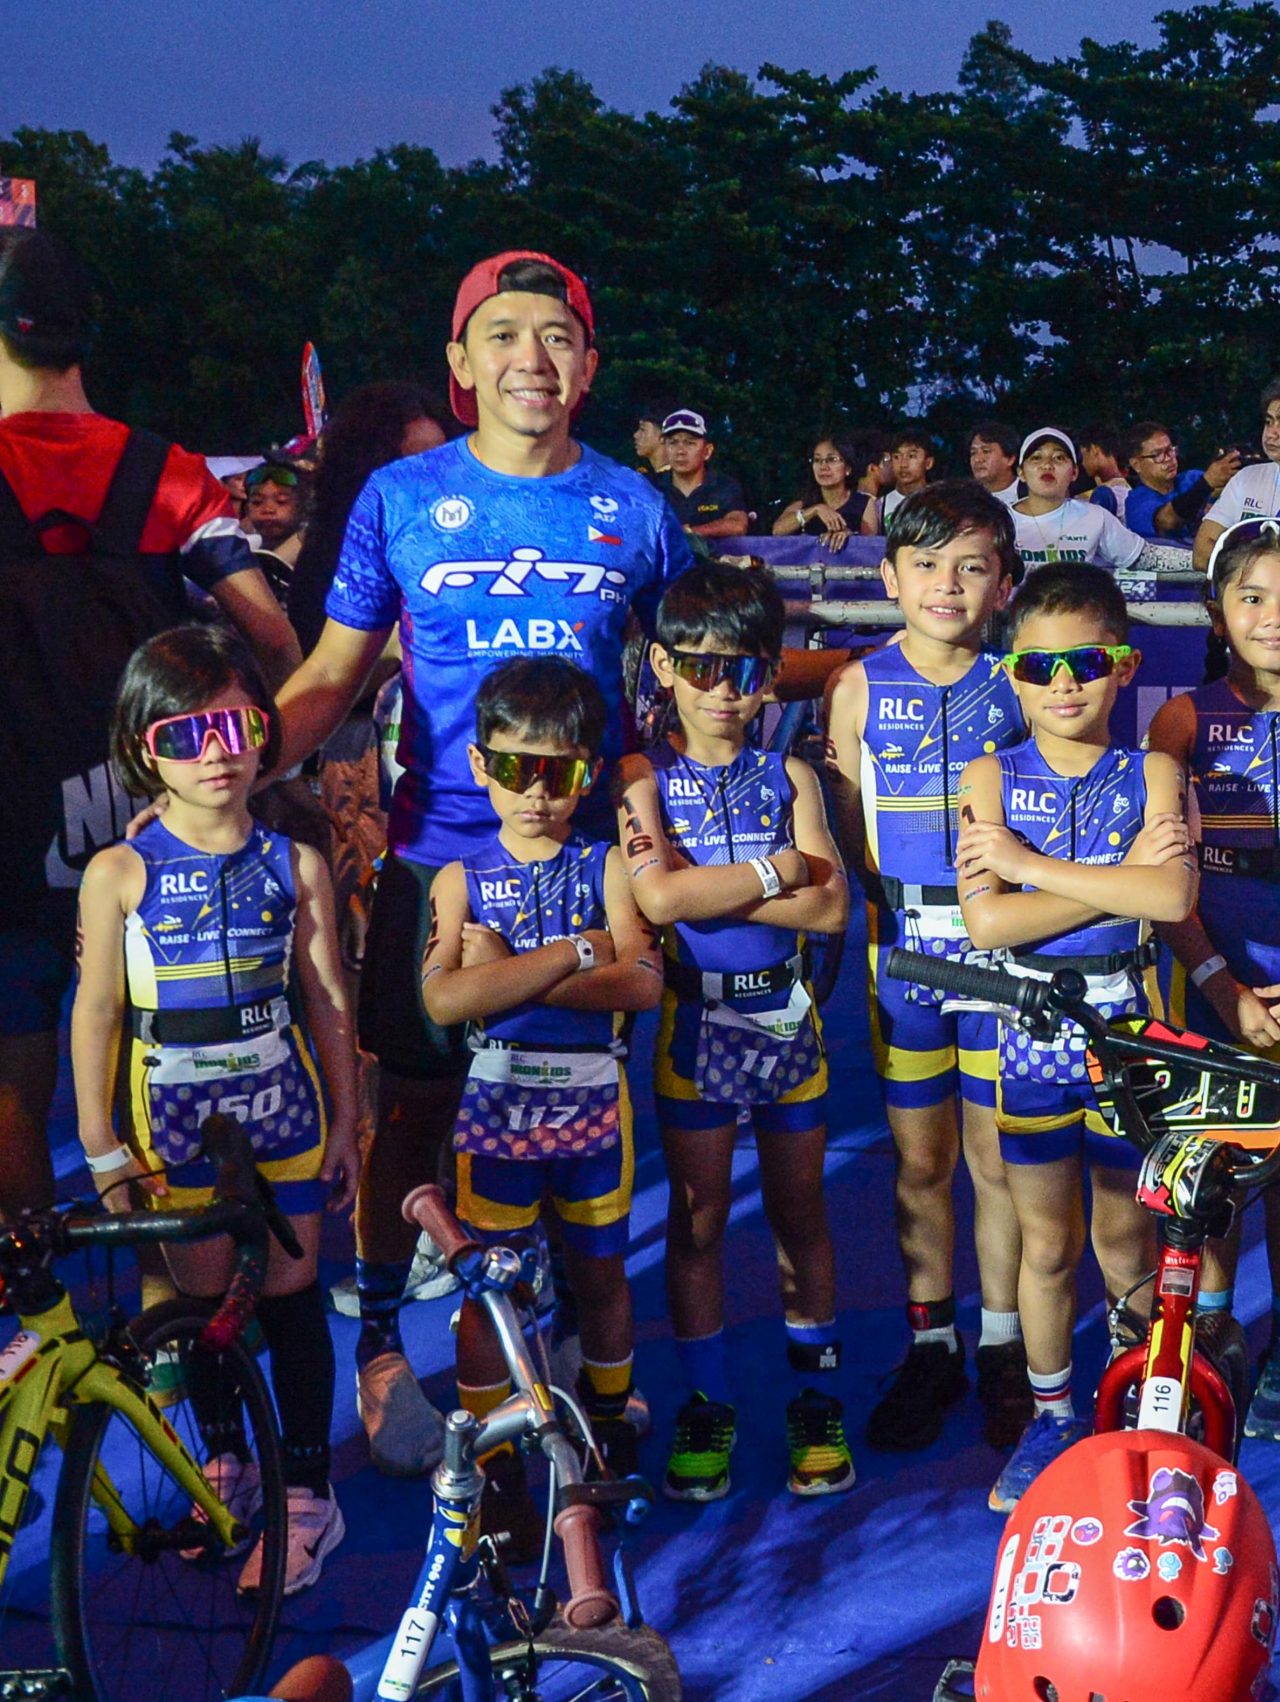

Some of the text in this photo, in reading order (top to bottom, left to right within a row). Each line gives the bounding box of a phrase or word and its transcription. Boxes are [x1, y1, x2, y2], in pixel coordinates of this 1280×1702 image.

[600, 588, 627, 605] PH
[1117, 581, 1147, 595] 24
[466, 618, 586, 651] LABX
[879, 697, 924, 721] RLC
[878, 723, 925, 731] RESIDENCES
[1208, 724, 1254, 744] RLC
[885, 763, 912, 774] RAISE
[918, 763, 941, 773] LIVE
[668, 778, 705, 798] RLC
[1208, 783, 1239, 793] RAISE
[1247, 783, 1272, 793] LIVE
[1010, 788, 1057, 814] RLC
[1010, 813, 1056, 823] RESIDENCES
[703, 834, 727, 846] LIVE
[731, 831, 777, 843] CONNECT
[1074, 851, 1125, 865] CONNECT
[1204, 846, 1234, 866] RLC
[160, 870, 209, 896] RLC
[480, 879, 521, 902] RLC
[159, 927, 274, 946] RAISE LIVE CONNECT
[514, 938, 537, 949] LIVE
[734, 970, 771, 991] RLC
[734, 988, 772, 998] RESIDENCES
[508, 1103, 580, 1131] 117
[1153, 1384, 1172, 1413] 116
[427, 1553, 446, 1580] 900
[400, 1619, 426, 1658] 117
